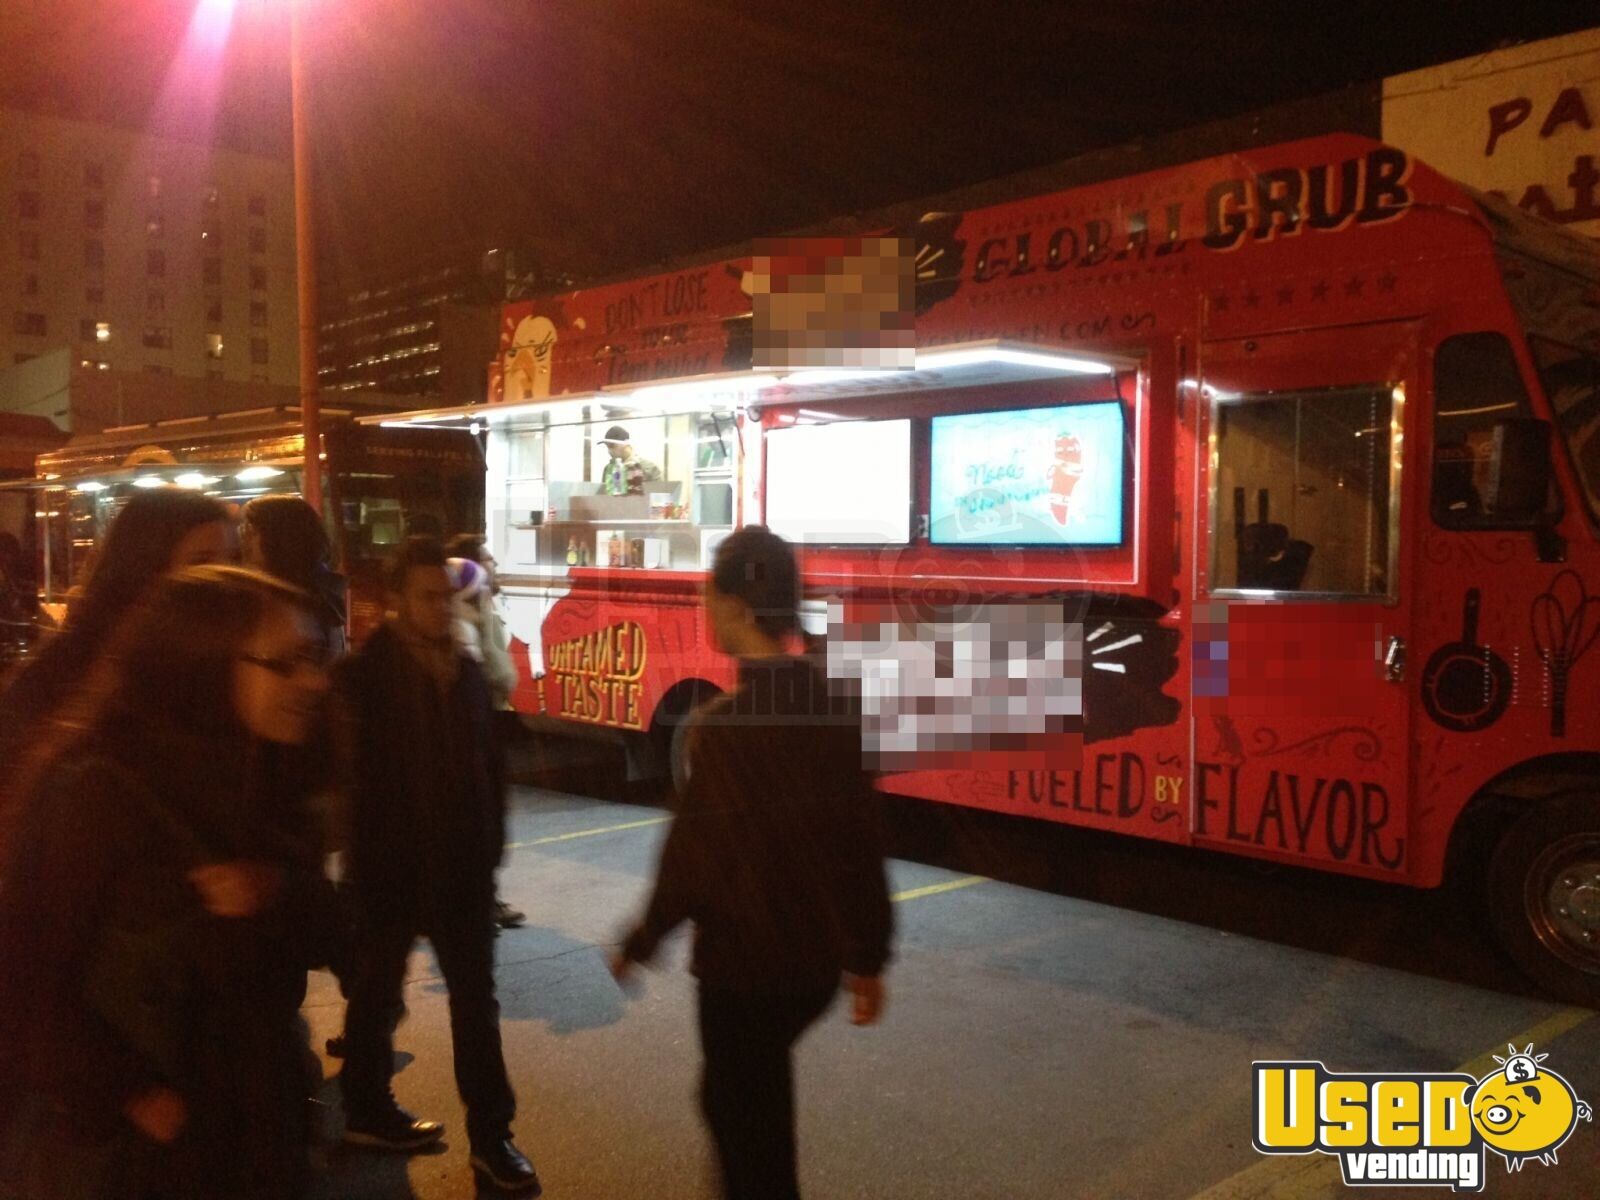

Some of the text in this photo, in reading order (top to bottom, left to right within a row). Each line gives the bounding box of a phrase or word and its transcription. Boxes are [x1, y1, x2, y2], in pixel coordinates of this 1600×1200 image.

[1204, 148, 1414, 253] GRUB
[662, 271, 709, 316] LOSE
[549, 620, 648, 681] UNTAMED
[554, 675, 644, 730] TASTE
[1008, 753, 1406, 871] FUELED BY FLAVOR
